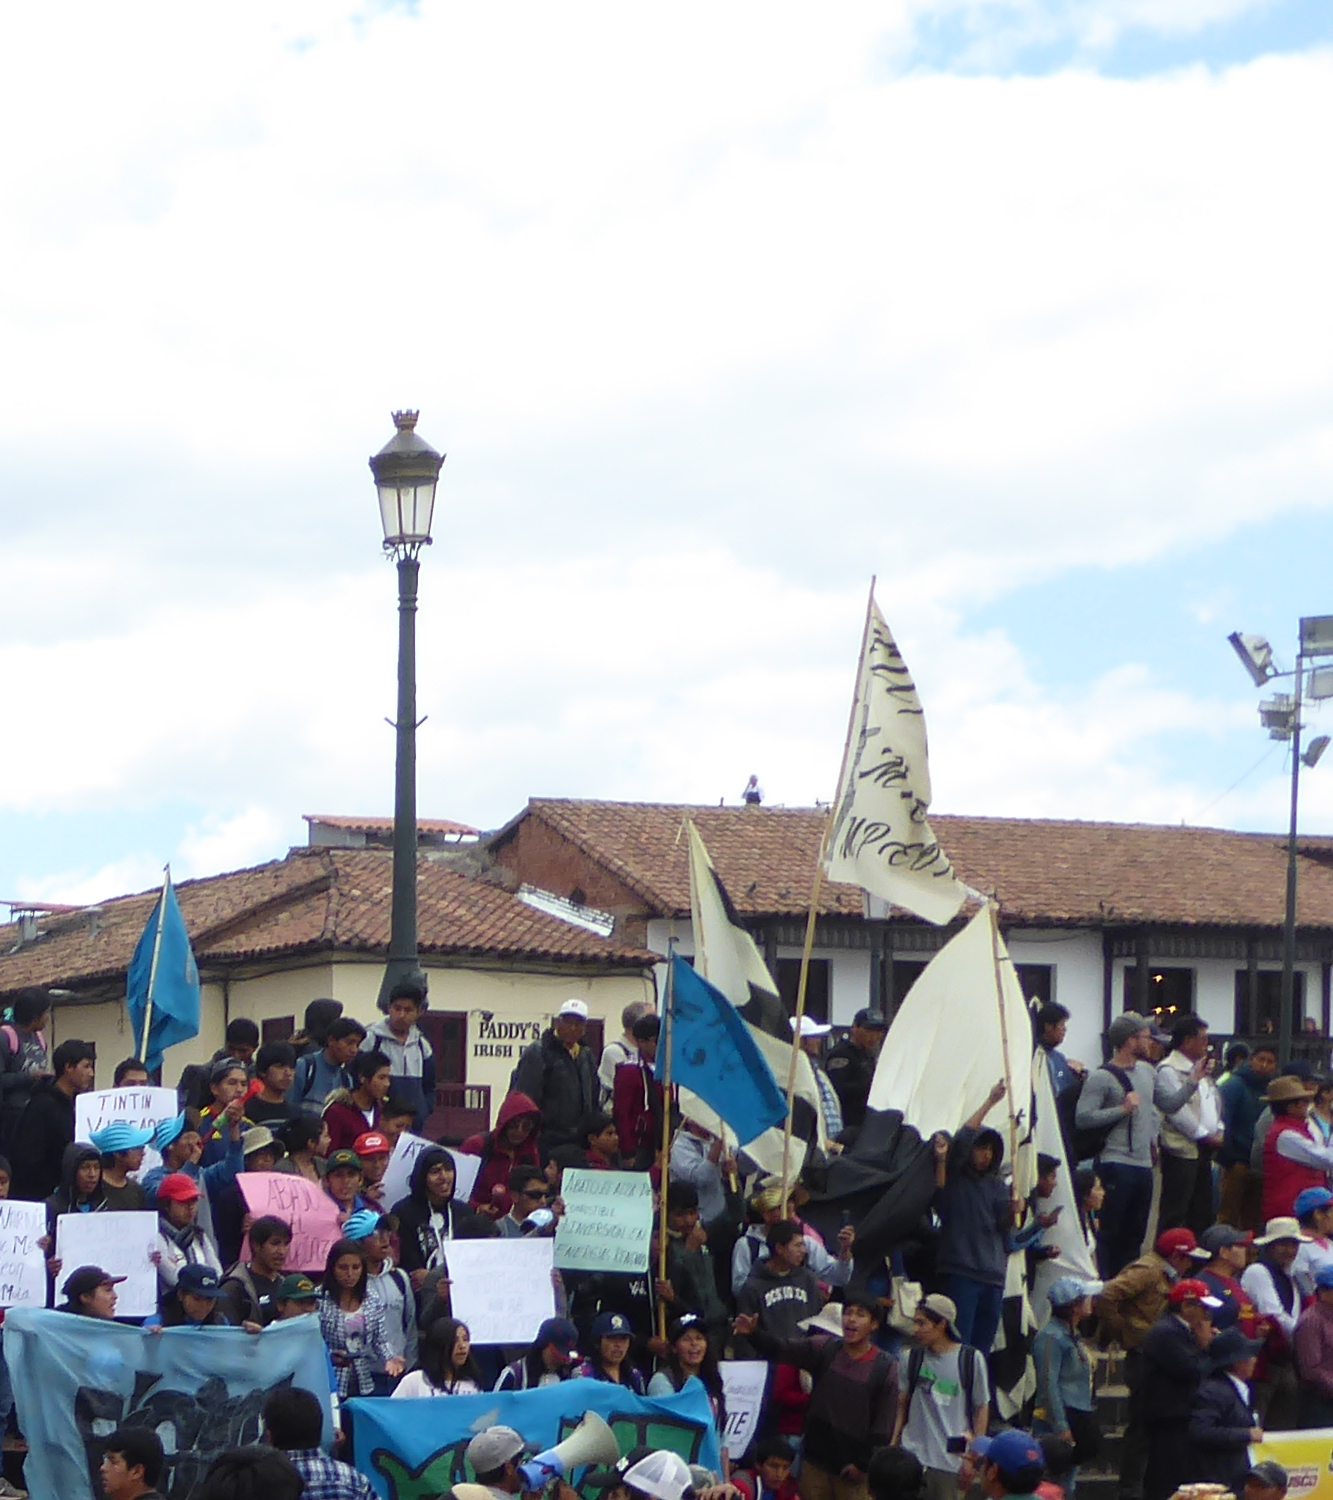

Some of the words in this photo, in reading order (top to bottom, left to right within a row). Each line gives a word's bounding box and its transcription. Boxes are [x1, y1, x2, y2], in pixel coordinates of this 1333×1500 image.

[479, 1021, 540, 1040] PADDY'S
[474, 1044, 513, 1057] IRISH
[98, 1093, 152, 1111] TINTIN
